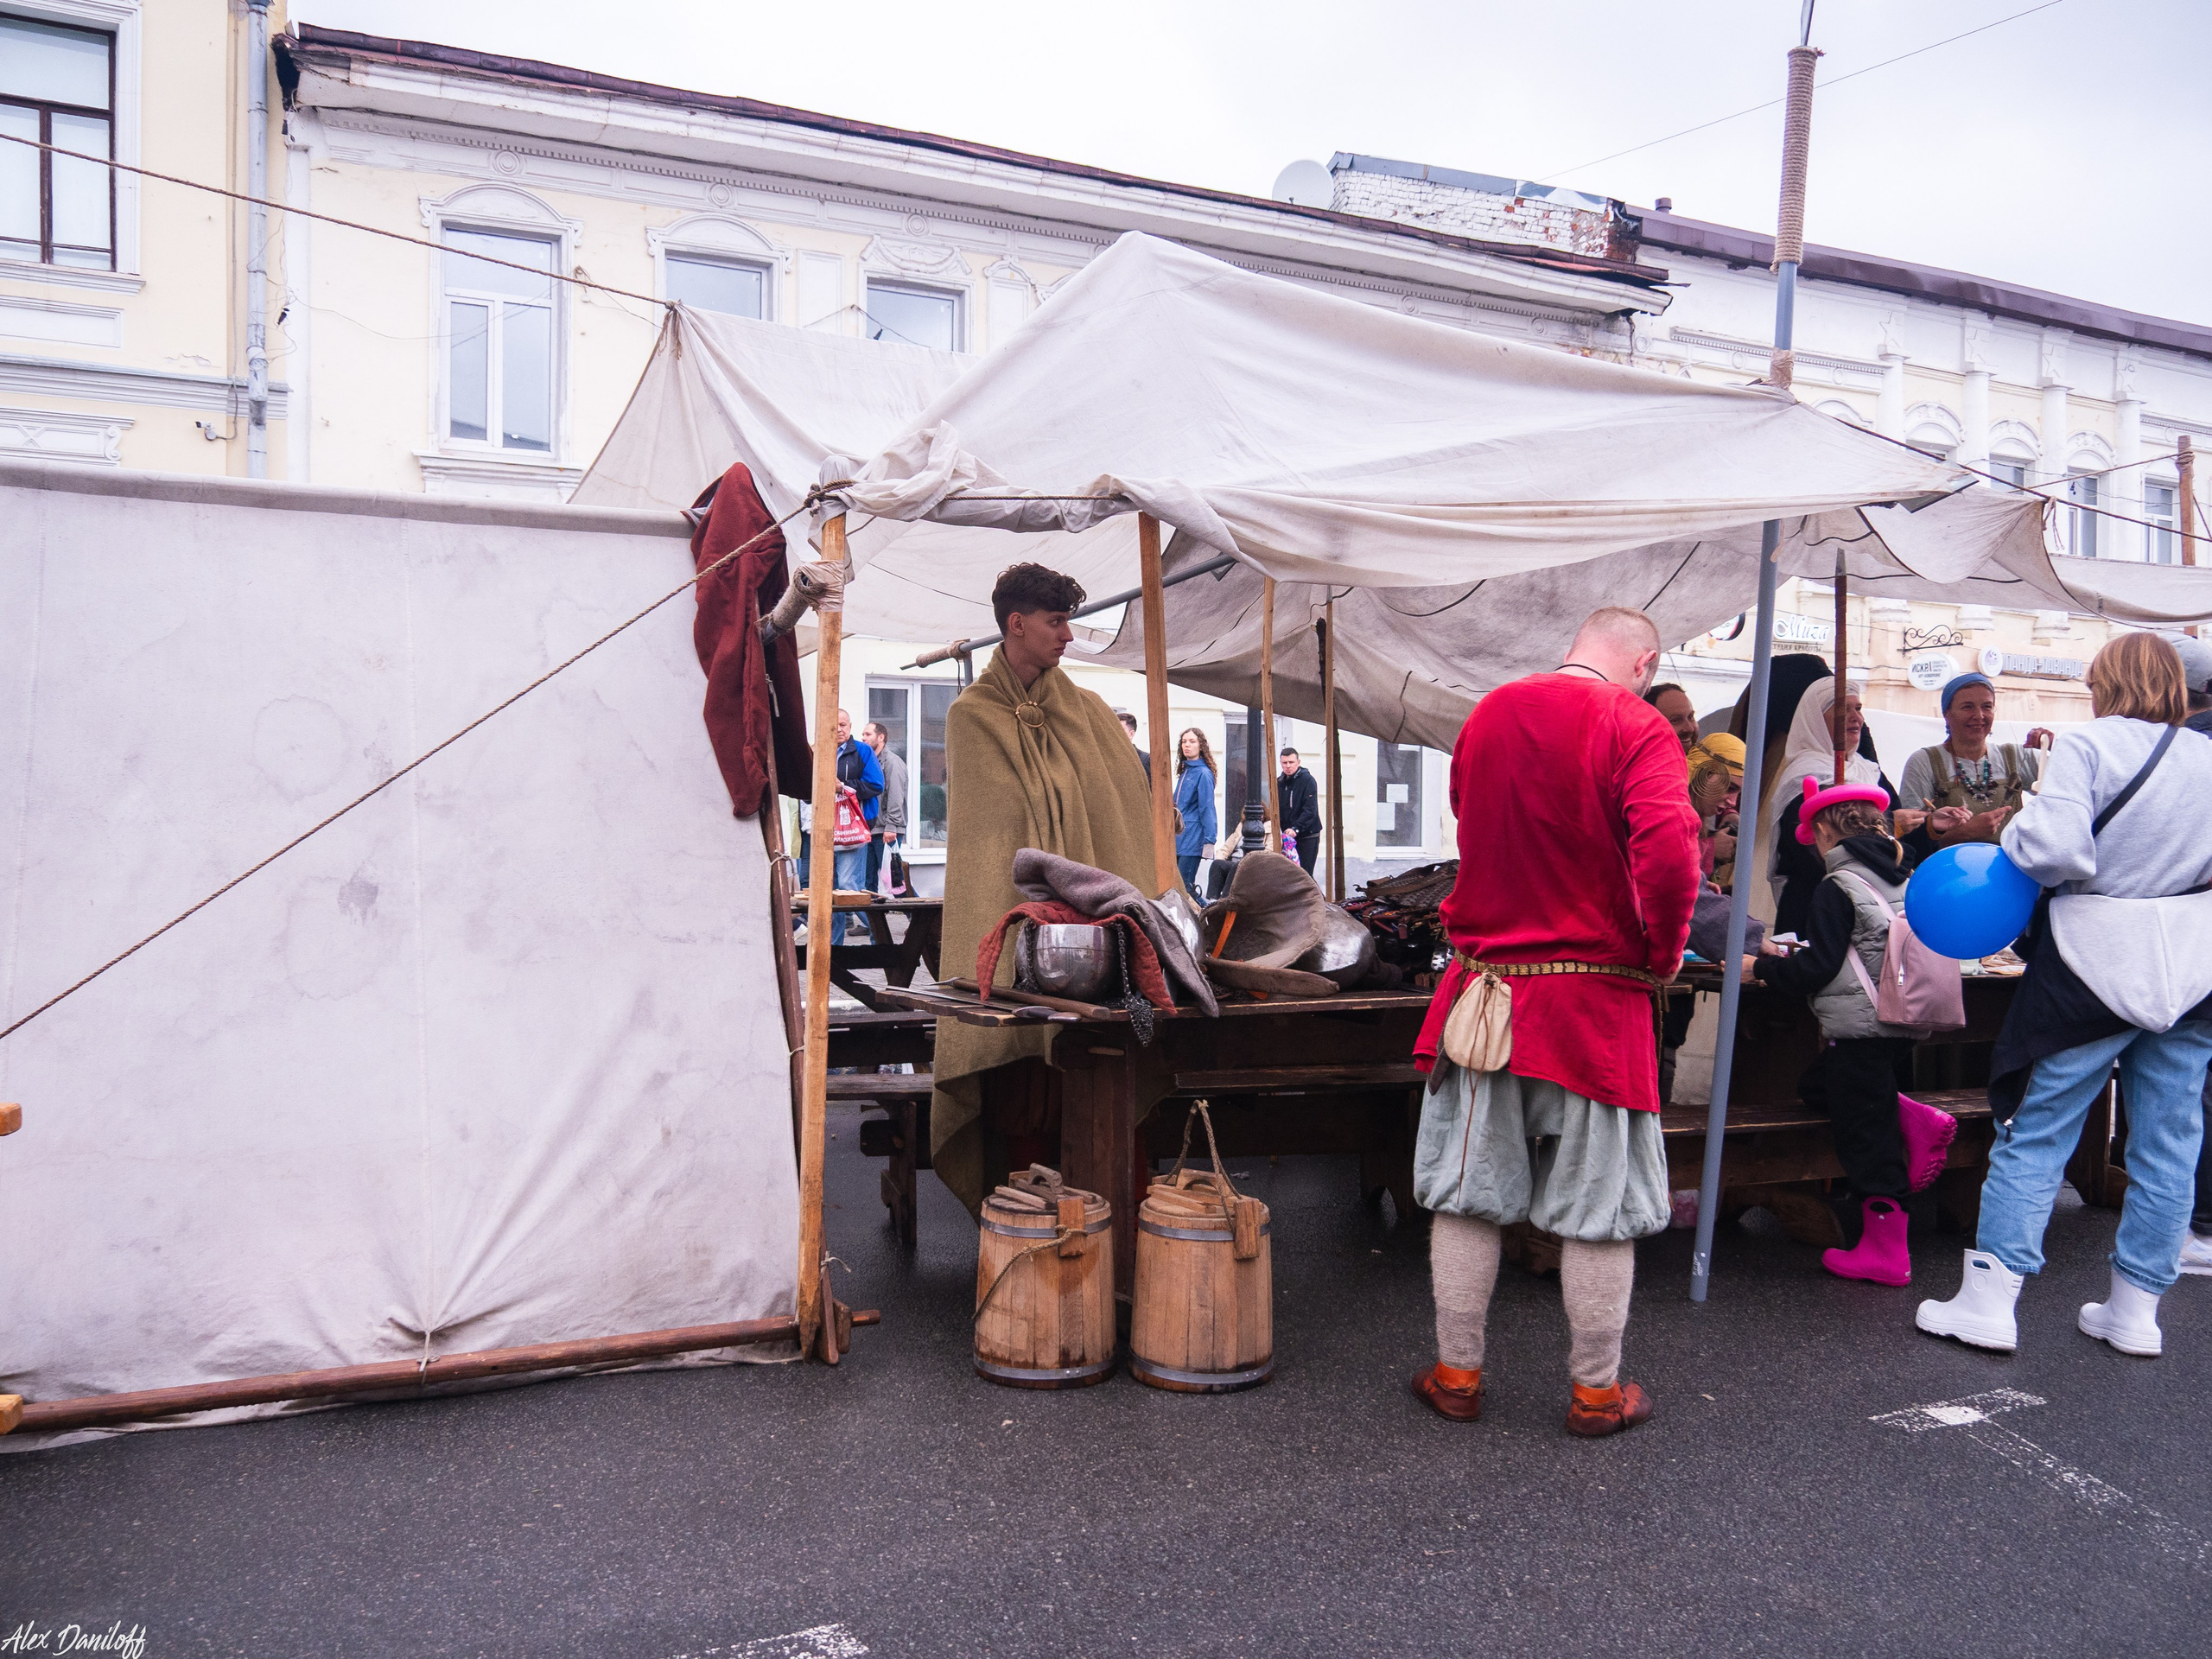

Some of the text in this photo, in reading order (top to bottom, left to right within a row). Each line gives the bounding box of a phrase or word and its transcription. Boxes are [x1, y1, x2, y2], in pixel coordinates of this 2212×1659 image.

[1772, 643, 1821, 652] ТУДИЯ КРАСОТЫ
[834, 834, 865, 842] РИЛОЖЕНИЕ
